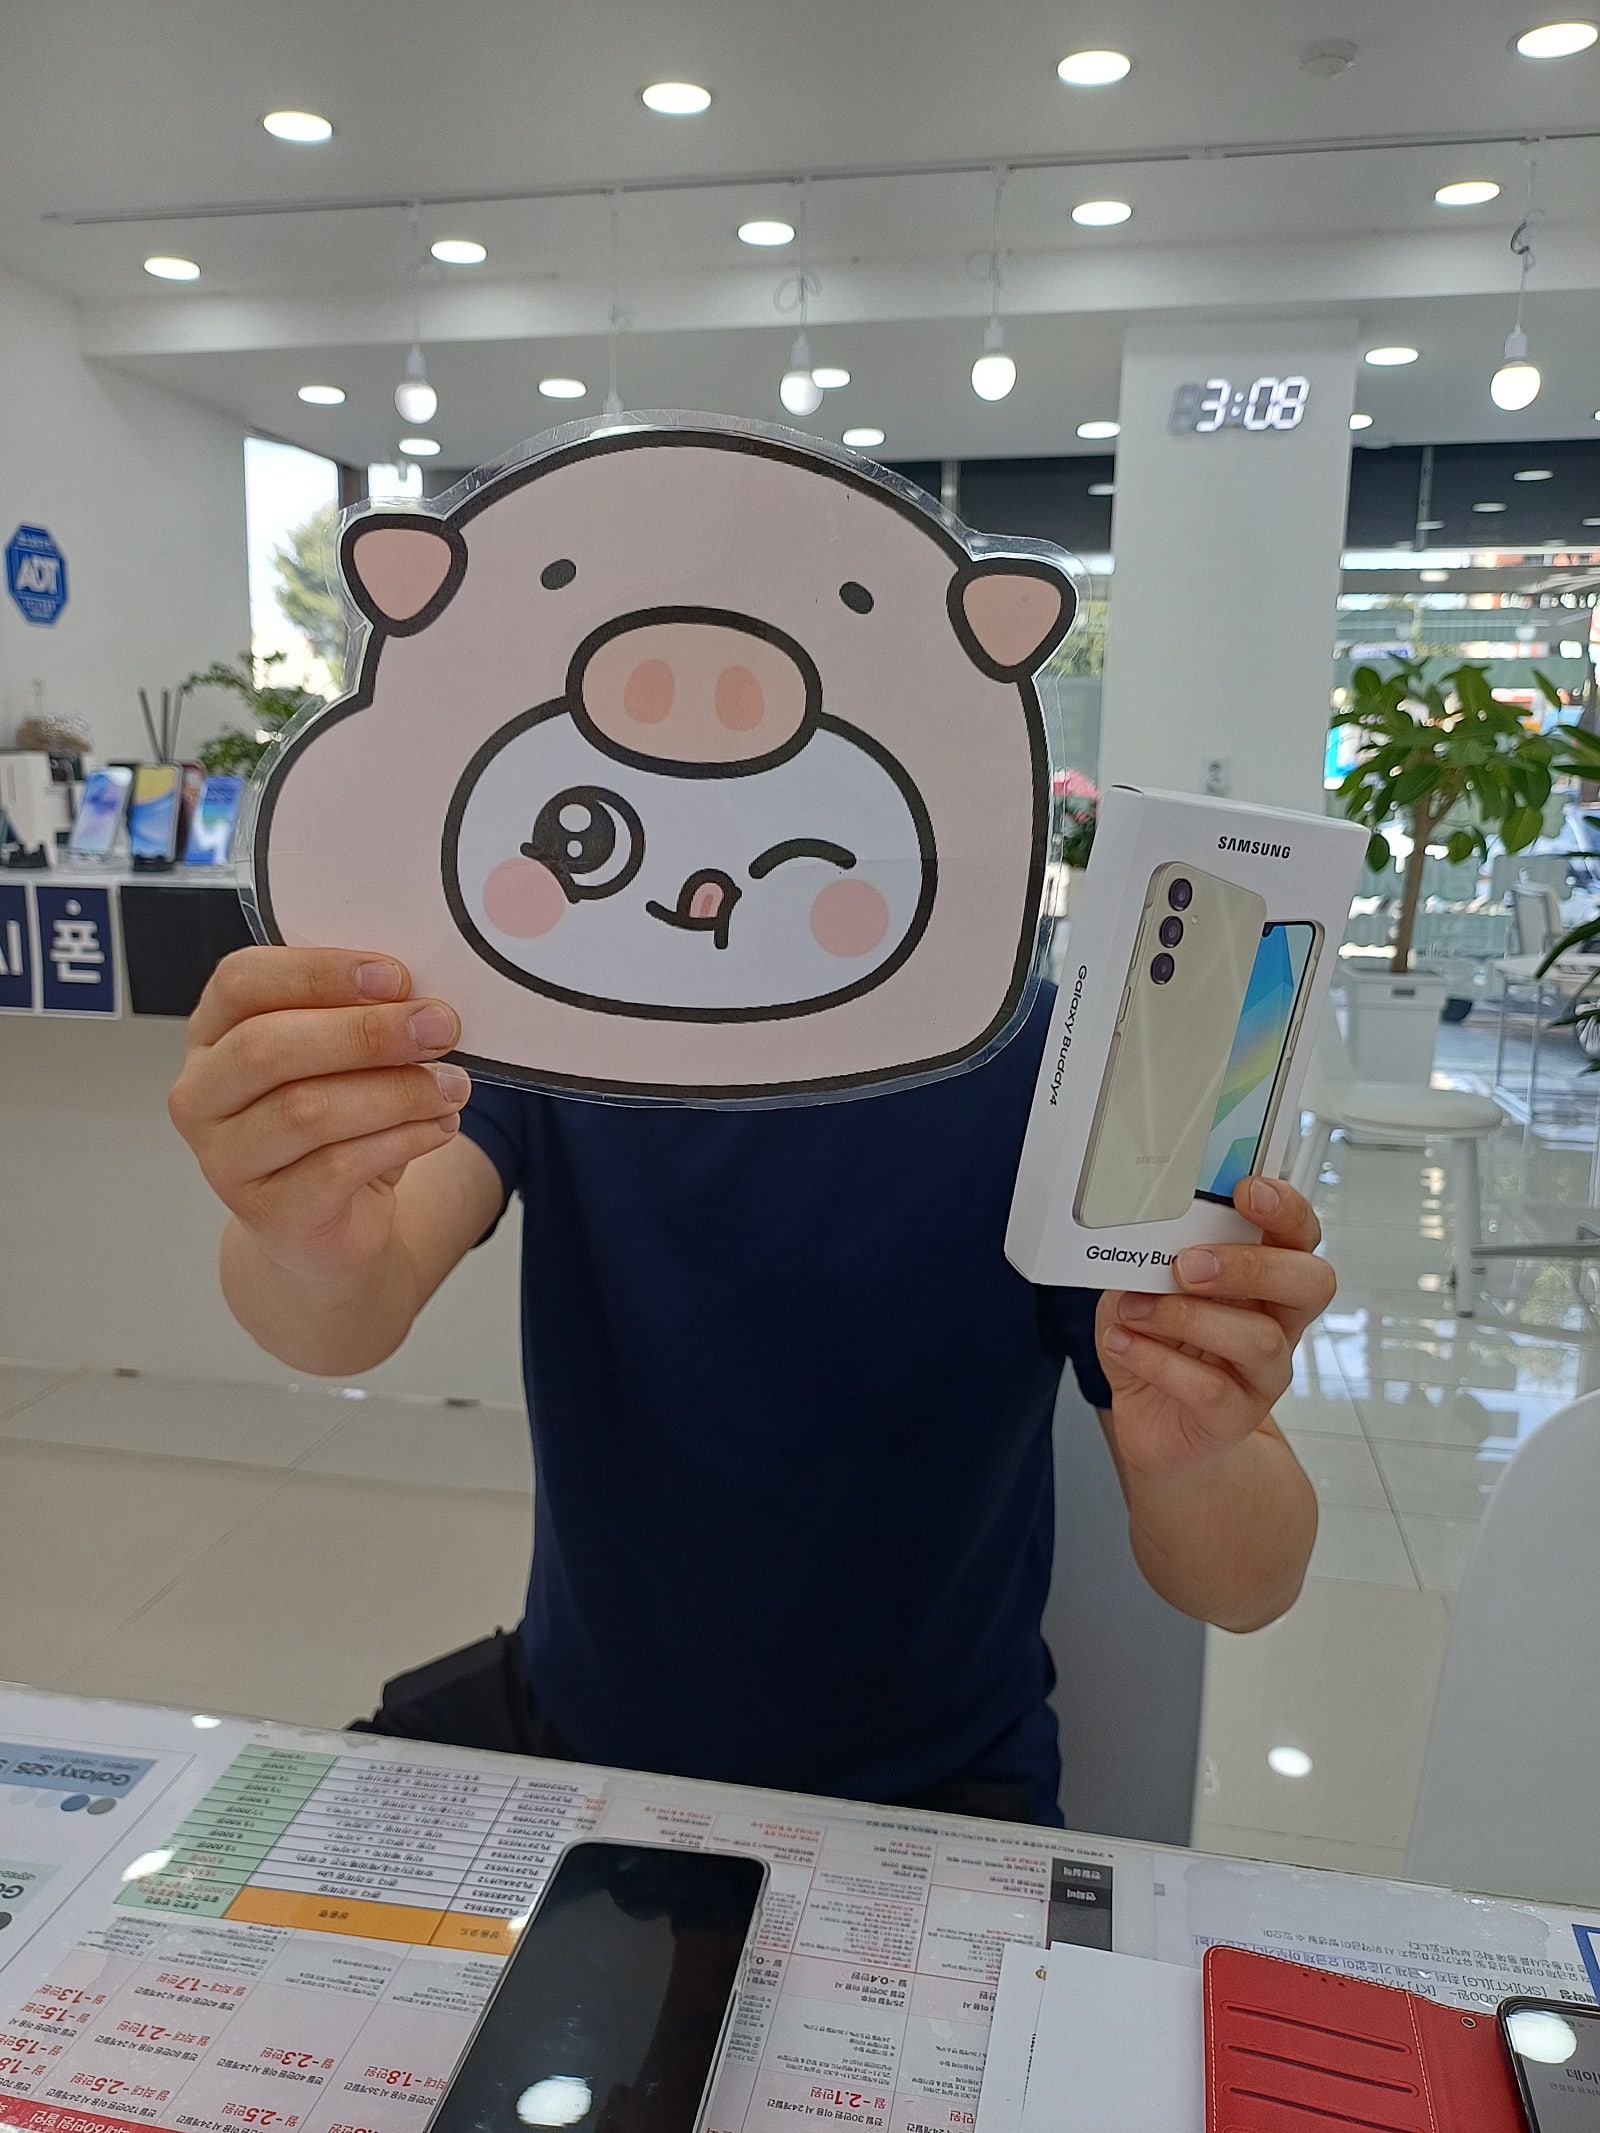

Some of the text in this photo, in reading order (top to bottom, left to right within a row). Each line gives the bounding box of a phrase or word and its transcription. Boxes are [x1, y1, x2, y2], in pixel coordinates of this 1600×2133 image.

[1196, 377, 1310, 432] 3:08
[16, 553, 58, 595] ADT
[1217, 836, 1291, 859] SAMSUNG
[1049, 964, 1088, 1106] Galaxy Buddy4
[1086, 1245, 1178, 1268] Galaxy Bu
[12, 1761, 54, 1777] S25
[52, 1765, 131, 1786] Galaxy
[1295, 1934, 1305, 1942] 수
[1341, 1940, 1382, 1954] 위약금이
[1384, 1946, 1394, 1956] 시
[1303, 1953, 1339, 1967] 요금제
[1399, 1950, 1428, 1960] 미유지
[1431, 1954, 1472, 1966] 유지기간
[1343, 1959, 1391, 1974] 기준없이
[1512, 1966, 1544, 1976] 이하로
[850, 1972, 896, 1985] -0.4만원
[1546, 1969, 1578, 1981] 요금제
[156, 1972, 247, 1997] 월 최대 -1.7만원
[1462, 1975, 1547, 1998] [SK][KT][LG]
[34, 1984, 92, 2004] -1.3만원
[1449, 1990, 1505, 2005] ,000원~
[20, 2002, 76, 2022] -1.5만원
[116, 2020, 211, 2047] 월 최대 -2.1만원
[127, 2041, 138, 2050] 시
[137, 2043, 155, 2054] 이용
[216, 2058, 253, 2072] 24개월간
[260, 2047, 335, 2070] 월 -2.3만원
[251, 2064, 261, 2073] 시
[261, 2067, 278, 2076] 이용
[1566, 2068, 1600, 2084] 데이
[364, 2065, 423, 2088] -1.8만원
[46, 2088, 82, 2101] 24개월간
[70, 2072, 170, 2102] 월 최대 -2.5만원
[343, 2081, 380, 2095] 36개월간
[379, 2088, 390, 2097] 시
[390, 2089, 407, 2100] 이용
[80, 2095, 91, 2104] 시
[90, 2098, 107, 2107] 이용
[810, 2086, 887, 2110] 월 -2.1만원
[29, 2110, 60, 2127] 할인
[221, 2102, 299, 2127] 월 -2.5만원
[766, 2099, 883, 2127] 전월 30만원 이용 시 24개월간
[175, 2114, 213, 2129] 24개월간
